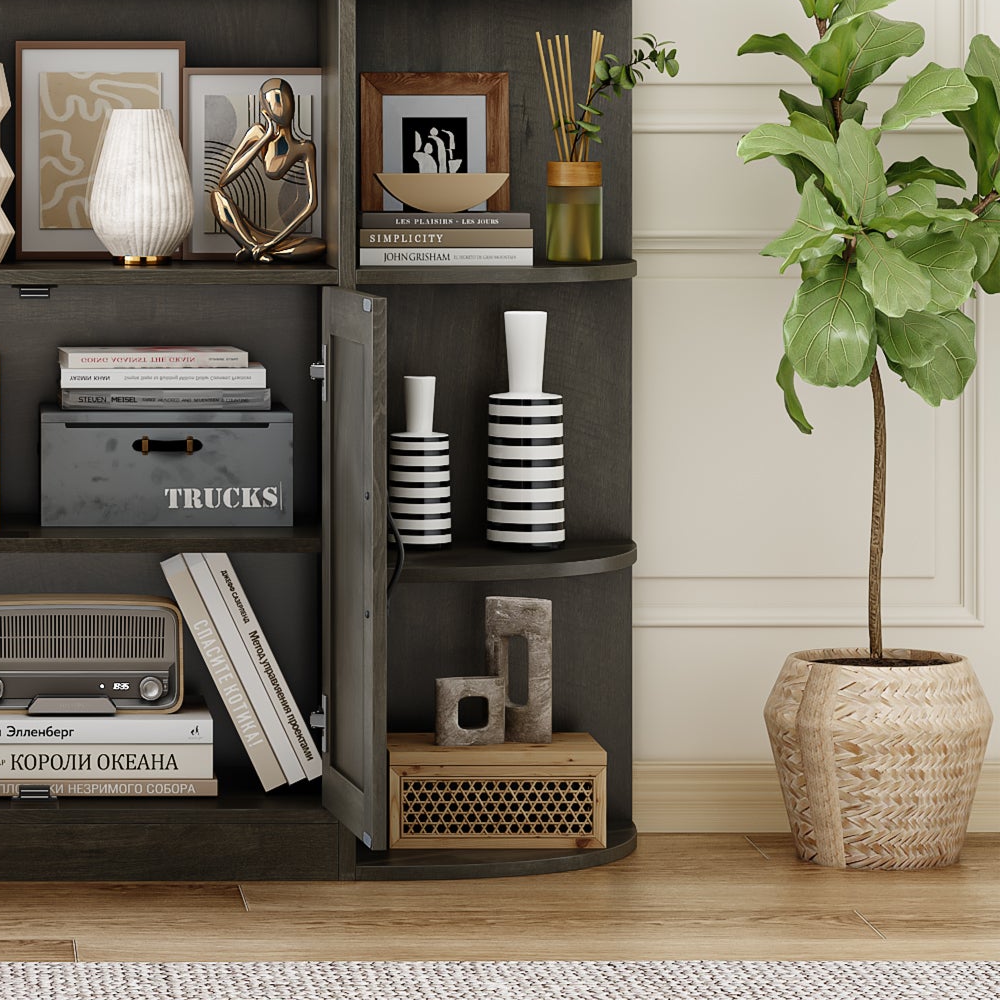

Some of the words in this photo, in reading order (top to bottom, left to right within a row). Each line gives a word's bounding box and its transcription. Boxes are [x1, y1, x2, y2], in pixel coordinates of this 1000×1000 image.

[369, 234, 443, 243] SIMPLICITY
[164, 486, 278, 509] TRUCKS
[220, 570, 236, 592] ДЖЕФФ
[231, 591, 250, 624] САЗЕРЛЕНД
[193, 619, 233, 684] СПАСИТЕ
[224, 684, 264, 748] КОТИКА!
[248, 630, 265, 662] Метод
[259, 657, 292, 714] управления
[287, 711, 314, 762] проектами
[6, 726, 74, 740] Элленберг
[10, 754, 92, 770] КОРОЛИ
[97, 754, 178, 770] ОКЕАНА
[68, 783, 142, 794] НЕЗРИМОГО
[146, 783, 195, 794] СОБОРА
